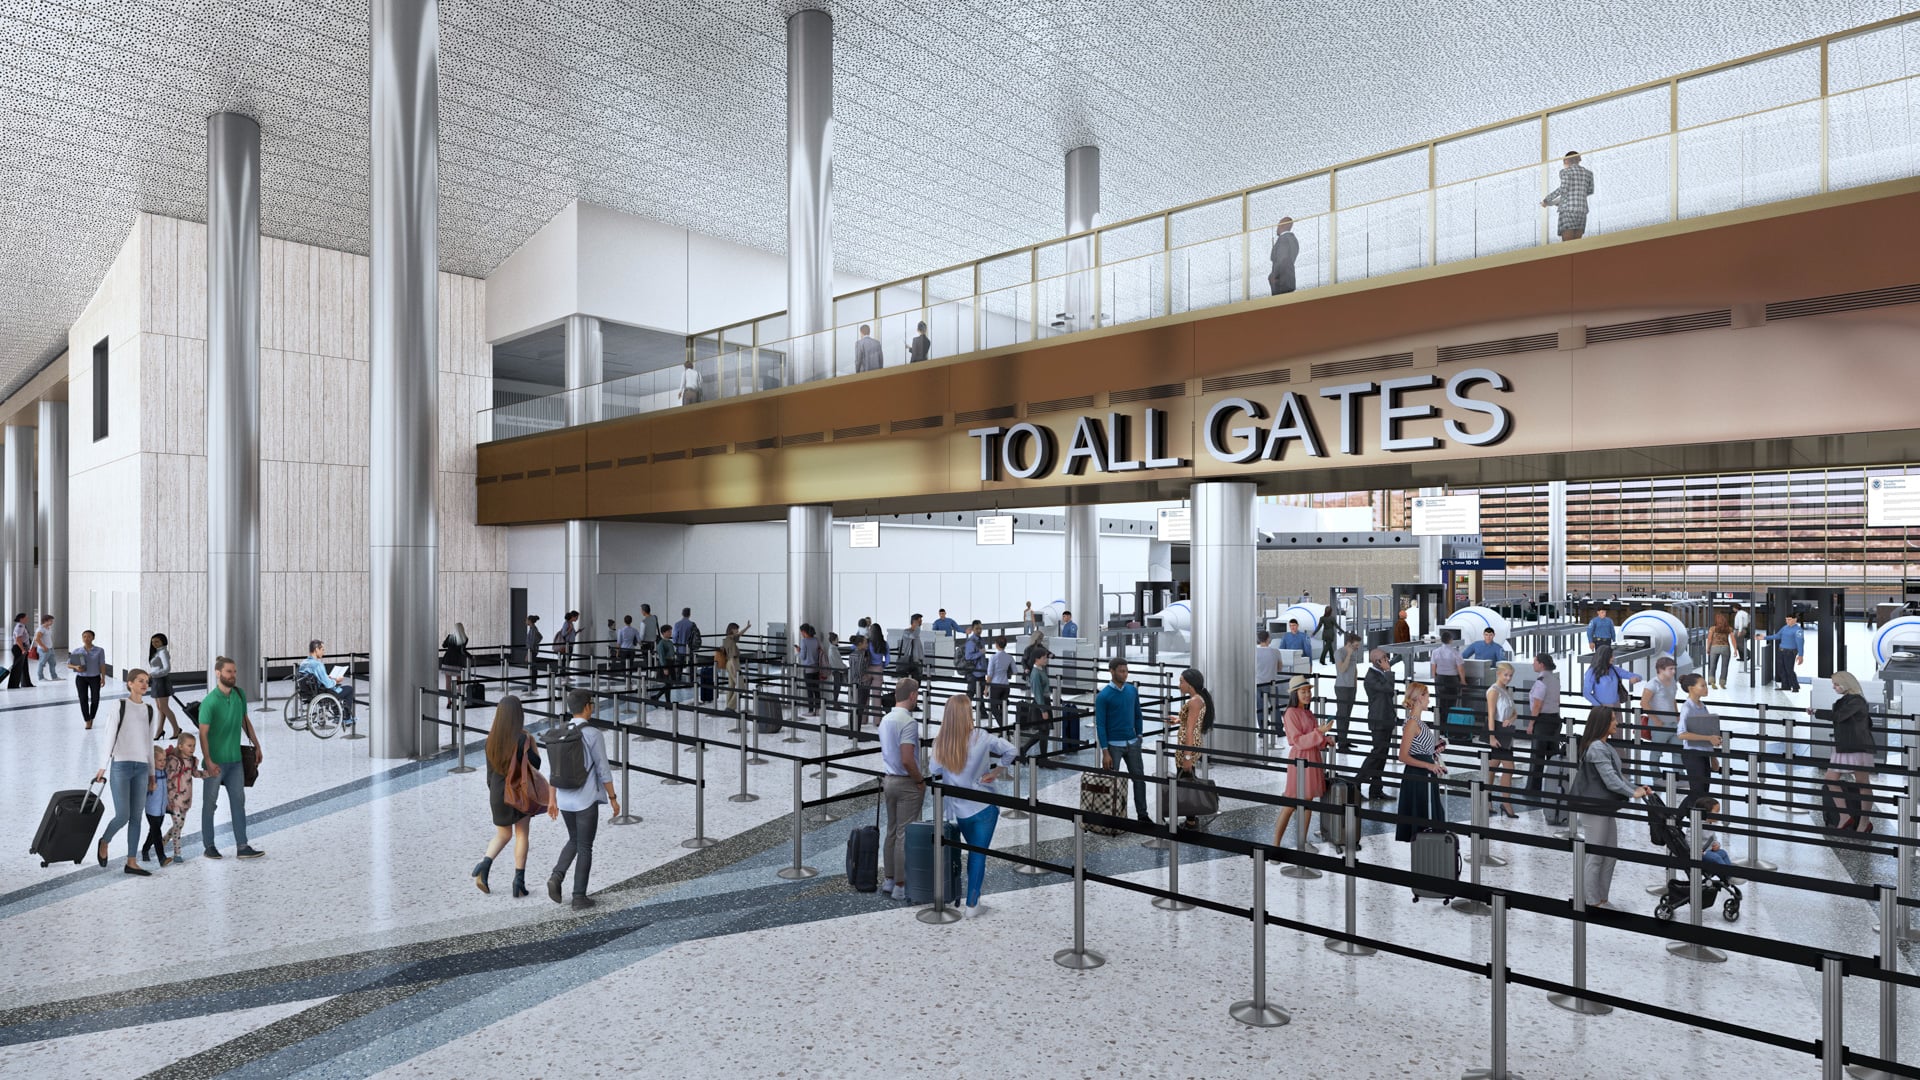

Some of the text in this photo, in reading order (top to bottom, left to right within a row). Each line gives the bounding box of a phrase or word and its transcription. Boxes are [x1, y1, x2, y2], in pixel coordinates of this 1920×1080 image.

[968, 368, 1508, 481] TO ALL GATES
[1872, 704, 1879, 714] 1
